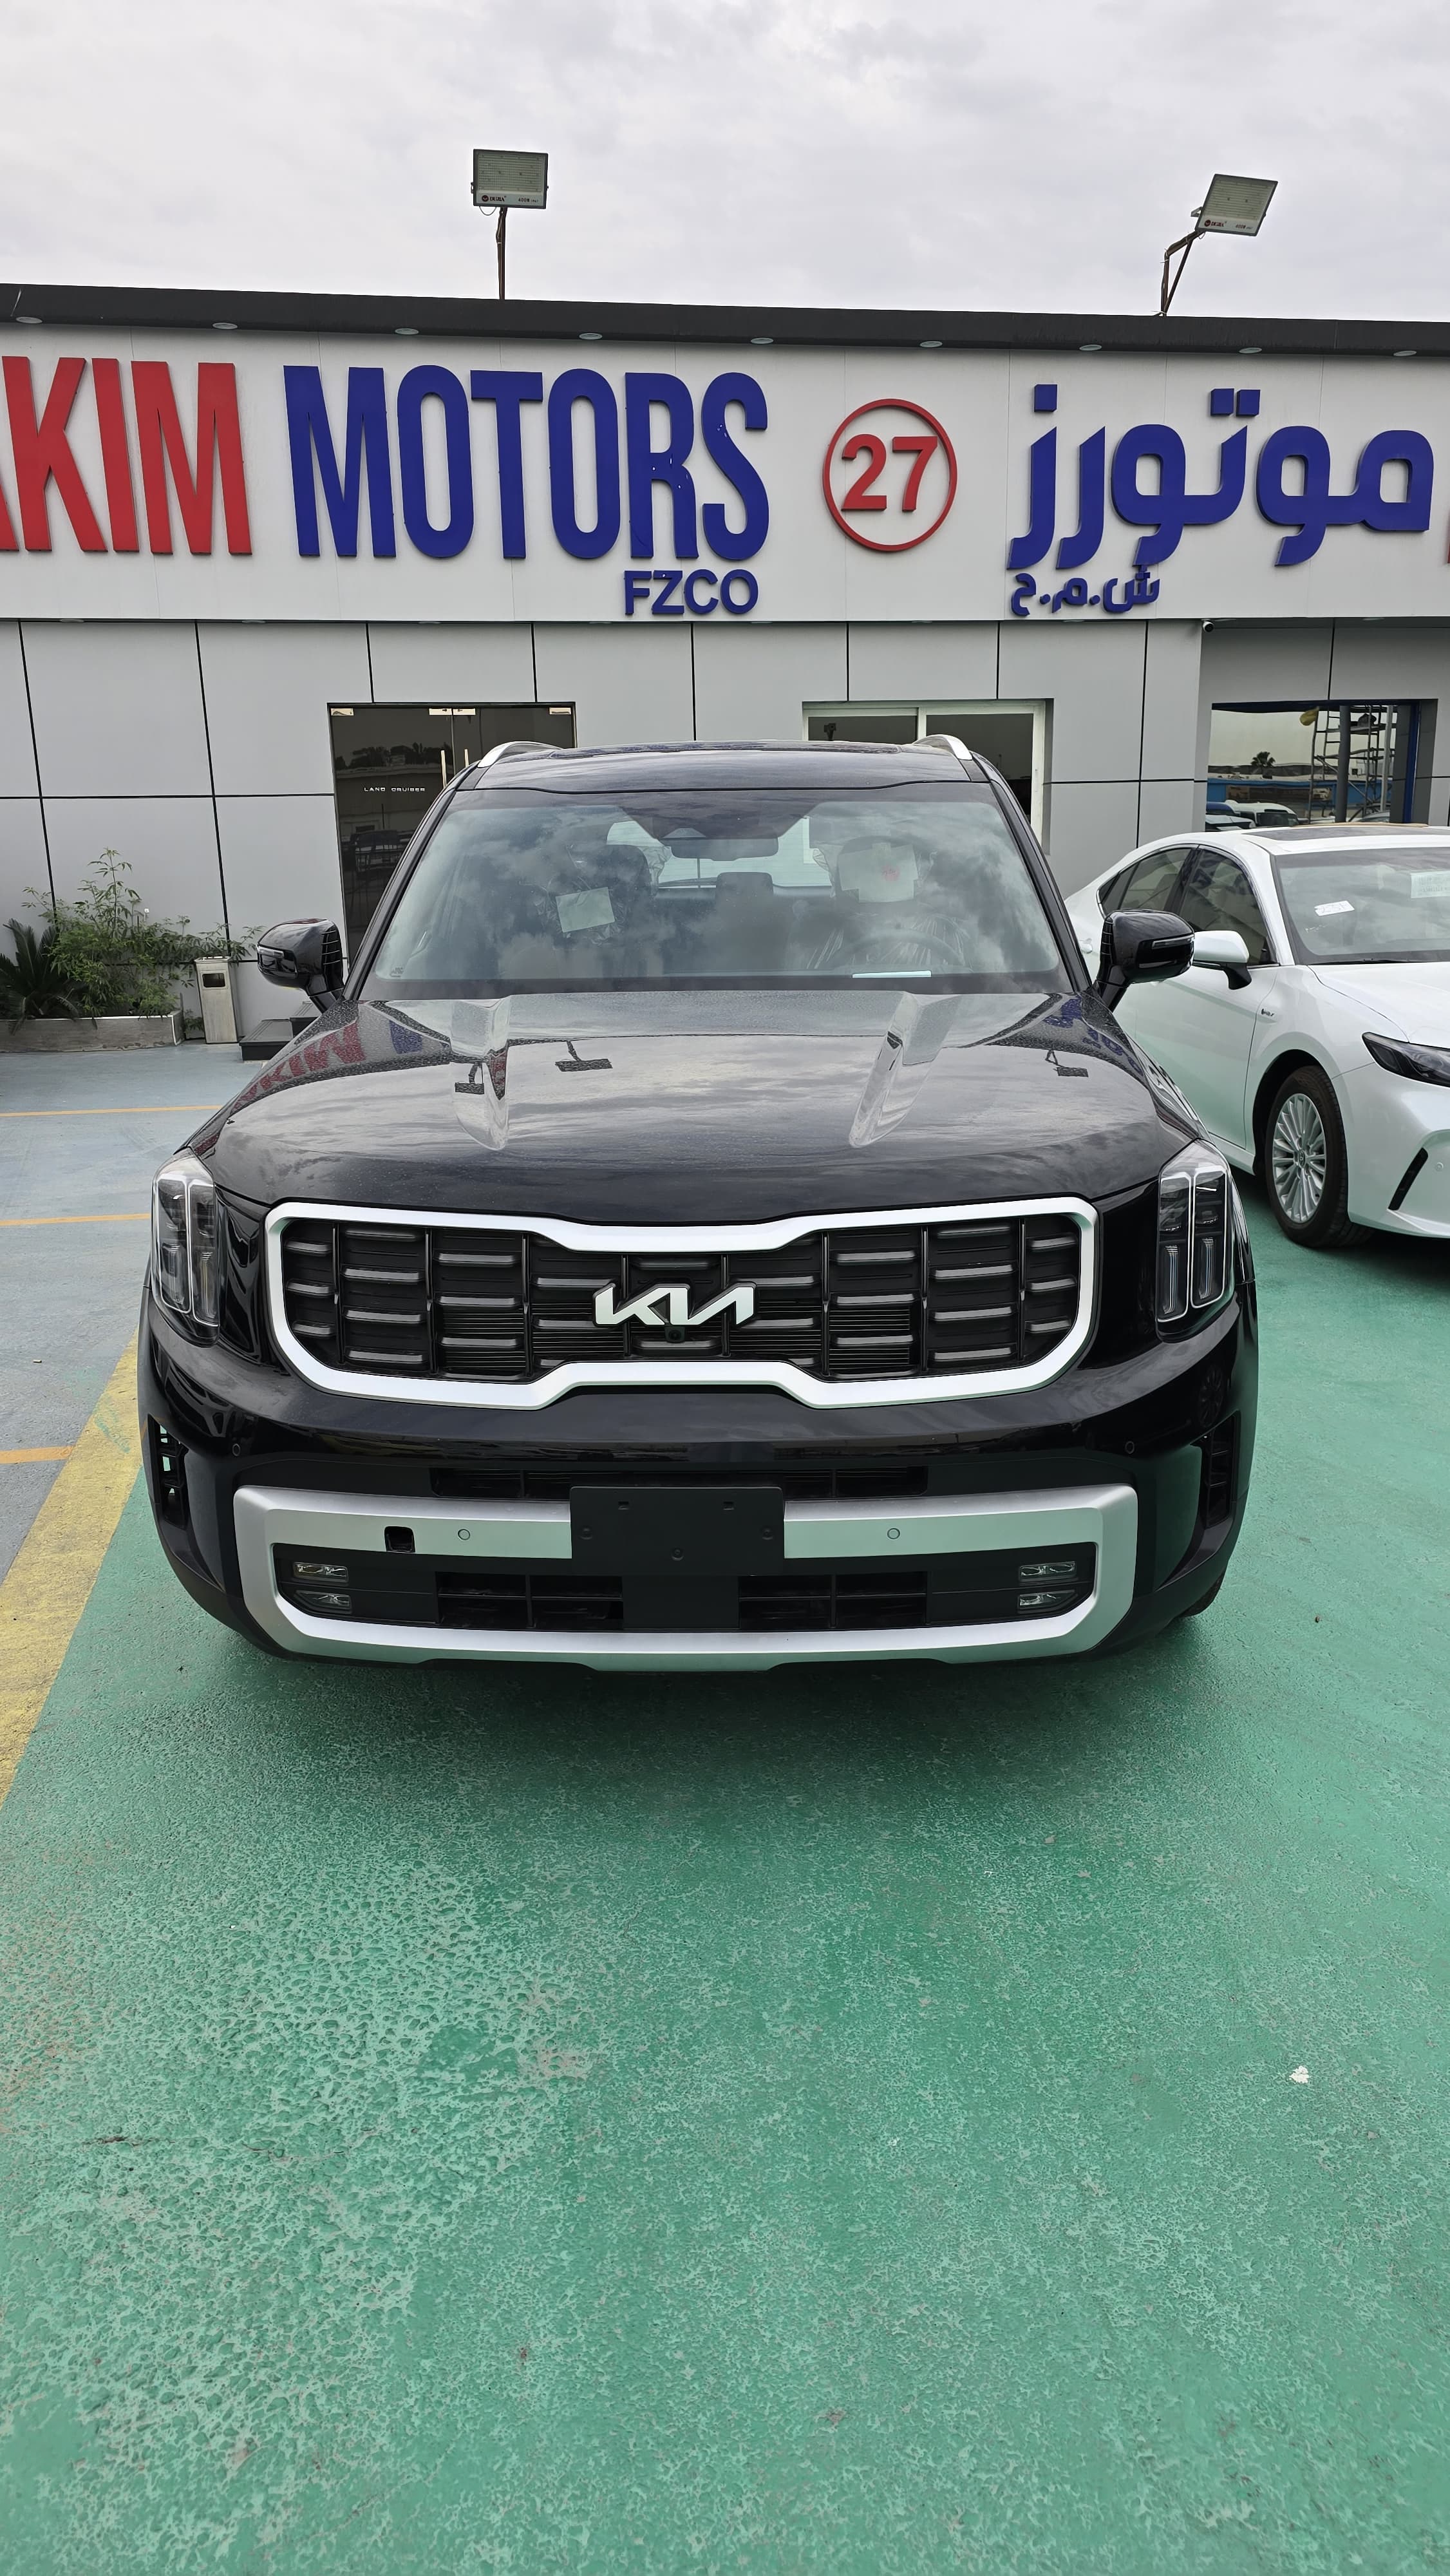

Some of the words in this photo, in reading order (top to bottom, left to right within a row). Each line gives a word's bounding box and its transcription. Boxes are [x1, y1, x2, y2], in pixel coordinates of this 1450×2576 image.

[0, 356, 252, 555] KIM
[283, 365, 769, 561] MOTORS
[841, 433, 939, 512] 27
[1006, 384, 1434, 570] موتورز
[624, 569, 759, 615] FZCO
[594, 1283, 756, 1325] KIA
